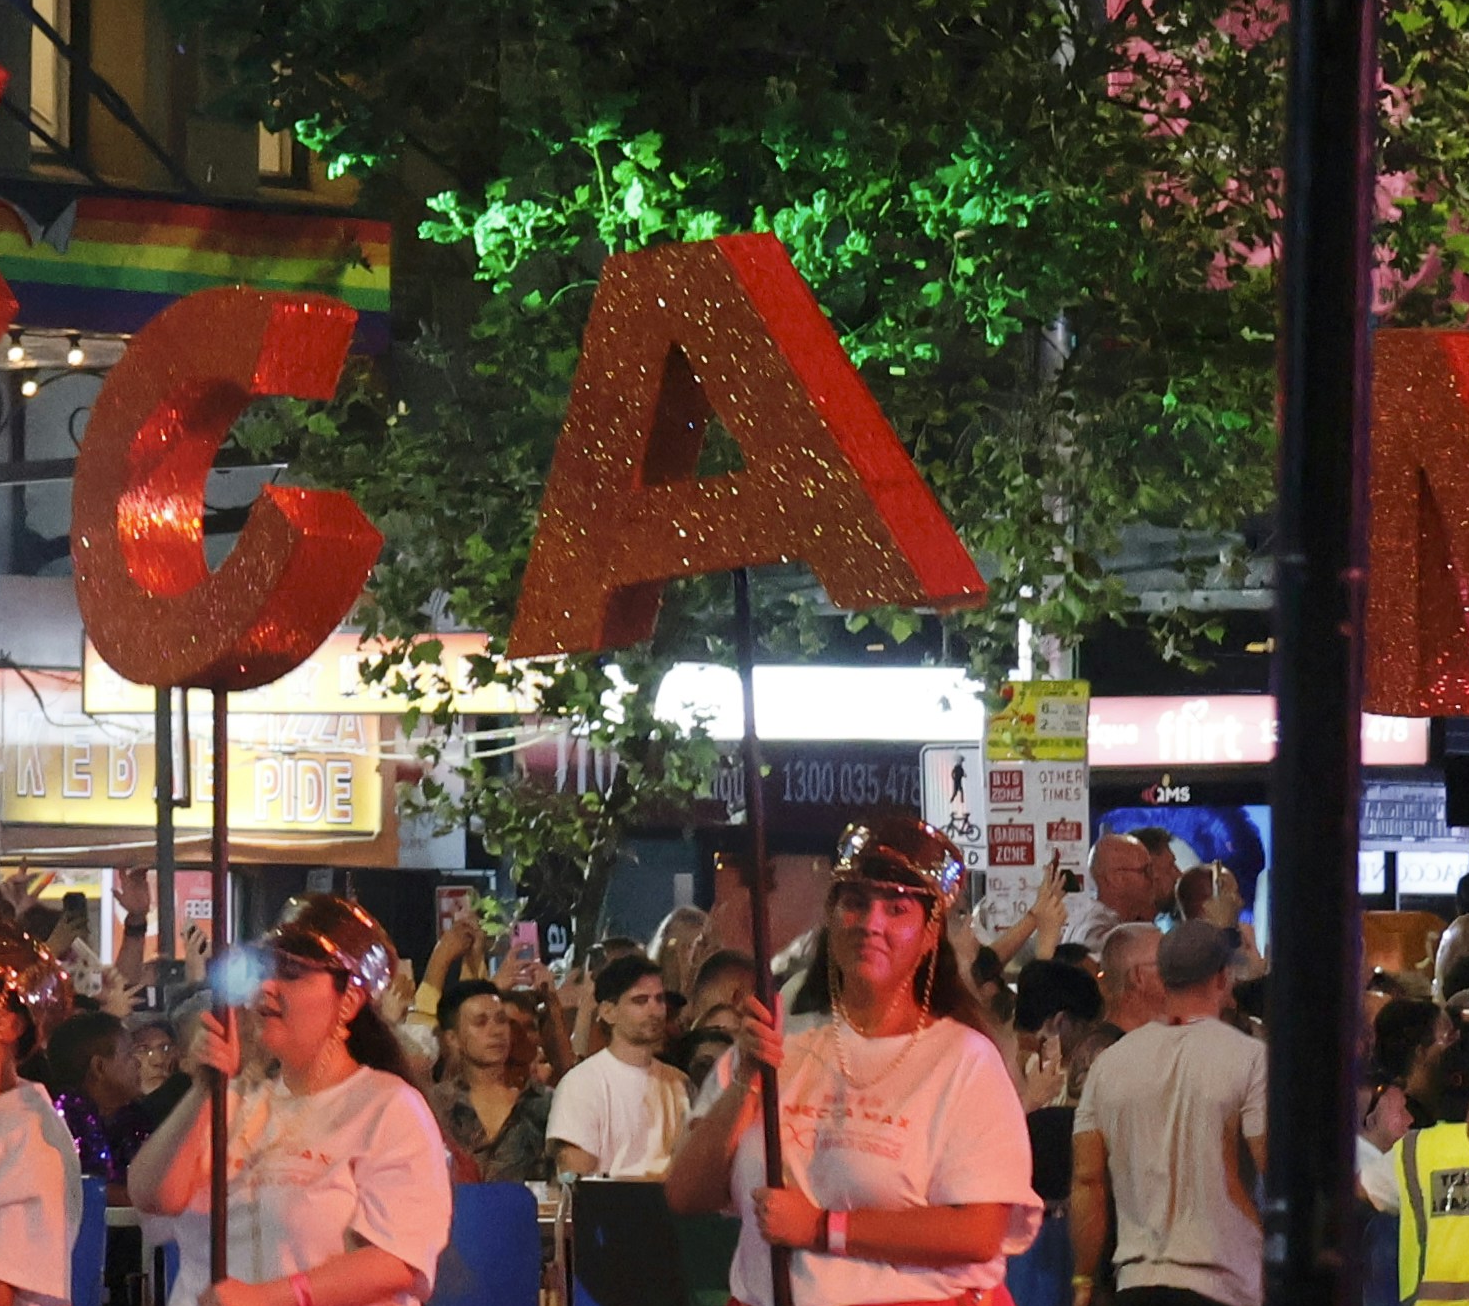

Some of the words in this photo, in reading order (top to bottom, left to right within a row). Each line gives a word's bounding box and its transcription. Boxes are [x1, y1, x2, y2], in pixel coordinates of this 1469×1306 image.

[1039, 770, 1083, 784] OTHER
[254, 756, 354, 824] PIDE
[1041, 787, 1082, 802] TIMES
[989, 825, 1033, 844] LOADING
[995, 845, 1027, 863] ZONE
